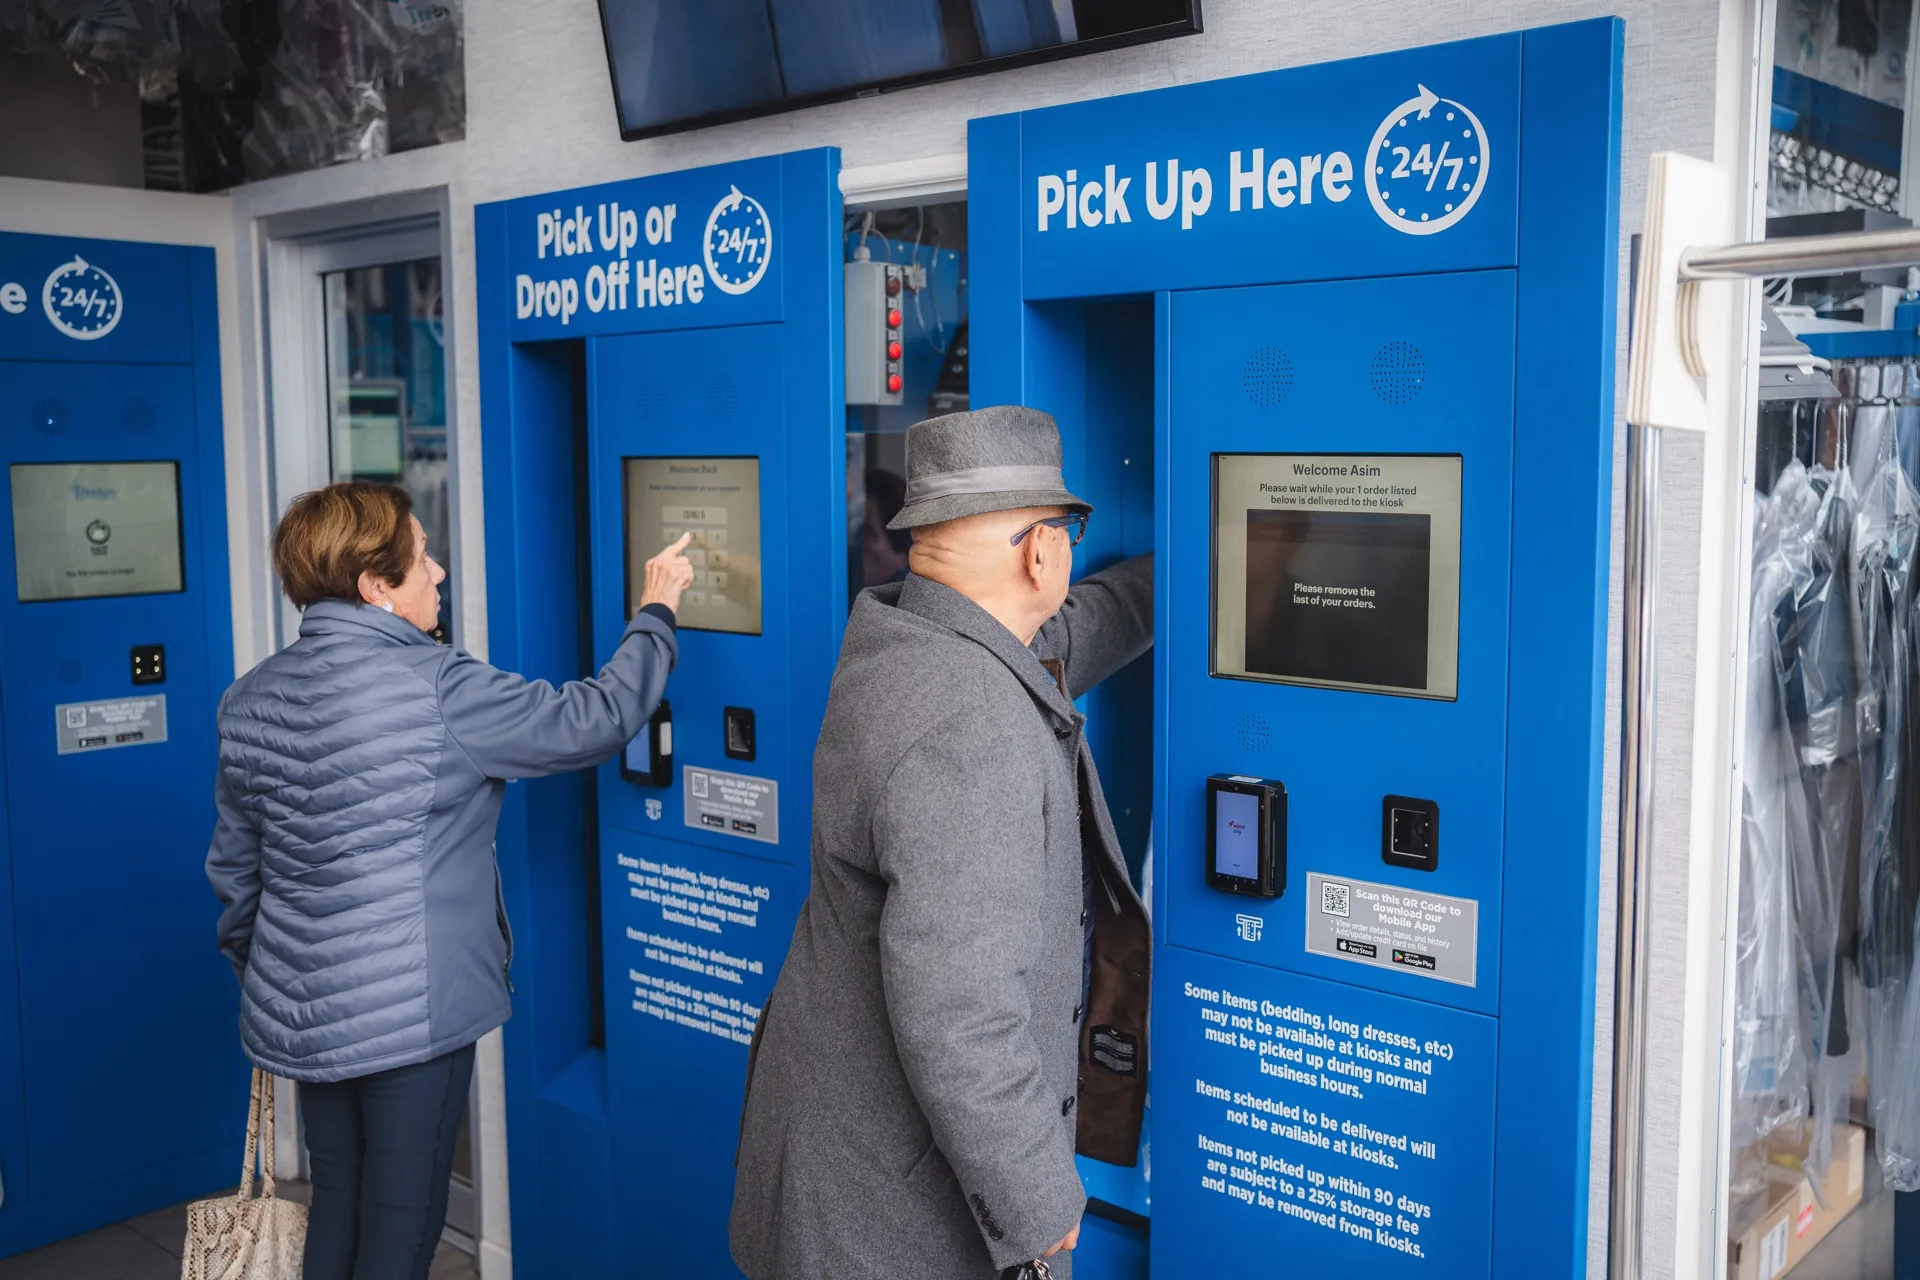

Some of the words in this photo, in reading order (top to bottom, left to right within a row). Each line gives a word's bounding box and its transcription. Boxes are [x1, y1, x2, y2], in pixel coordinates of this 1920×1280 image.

[1391, 141, 1463, 191] 24/7
[1038, 164, 1132, 231] Pick
[1146, 159, 1212, 229] Up
[1229, 148, 1353, 212] Here
[537, 206, 593, 259] Pick
[599, 202, 638, 258] Up
[645, 203, 676, 245] or
[718, 227, 757, 263] 24/7
[60, 287, 107, 318] 24/7
[516, 274, 579, 325] Drop
[585, 260, 629, 313] Off
[636, 258, 704, 308] Here
[1260, 483, 1287, 492] Please
[1289, 484, 1308, 493] wait
[1310, 485, 1333, 494] while
[1335, 487, 1354, 495] your
[1358, 486, 1361, 494] 1
[1364, 486, 1388, 494] order
[1391, 486, 1417, 495] listed
[1293, 464, 1347, 476] Welcome
[1351, 465, 1380, 476] Asim
[1271, 495, 1296, 504] below
[1298, 496, 1305, 504] is
[1308, 496, 1349, 505] delivered
[1363, 498, 1377, 506] the
[1380, 498, 1403, 507] kiosk
[1293, 594, 1309, 604] last
[1311, 596, 1320, 605] of
[1322, 598, 1341, 607] your
[1343, 598, 1375, 608] orders.
[1295, 583, 1322, 593] Please
[1325, 587, 1358, 595] remove
[1360, 587, 1375, 596] the
[1356, 890, 1379, 901] Scan
[1382, 893, 1400, 905] this
[1403, 897, 1417, 908] QR
[1421, 900, 1447, 913] Code
[1450, 906, 1461, 916] to
[1373, 903, 1423, 920] download
[1425, 912, 1442, 923] our
[1336, 919, 1350, 928] View
[1352, 922, 1368, 932] order
[1370, 926, 1391, 937] details,
[1393, 930, 1413, 940] status,
[1414, 934, 1426, 942] and
[1428, 936, 1449, 948] history
[1378, 914, 1412, 928] Mobile
[1414, 921, 1436, 933] App
[1360, 948, 1374, 956] Store
[1404, 957, 1422, 965] Google
[1423, 960, 1433, 968] Play
[1184, 982, 1219, 1003] Some
[1222, 990, 1257, 1012] items
[1261, 1000, 1325, 1031] (bedding,
[1329, 1015, 1358, 1038] long
[1363, 1024, 1420, 1053] dresses,
[1425, 1040, 1453, 1060] etc)
[1202, 1008, 1228, 1026] may
[1232, 1014, 1252, 1031] not
[1256, 1018, 1272, 1036] be
[1276, 1026, 1334, 1050] available
[1339, 1042, 1352, 1055] at
[1356, 1042, 1400, 1068] kiosks
[1404, 1056, 1431, 1075] and
[1205, 1028, 1236, 1046] must
[1240, 1034, 1256, 1050] be
[1259, 1041, 1302, 1063] picked
[1306, 1052, 1323, 1070] up
[1328, 1056, 1372, 1083] during
[1376, 1072, 1426, 1094] normal
[1260, 1058, 1317, 1086] business
[1320, 1076, 1363, 1099] hours.
[1196, 1079, 1230, 1101] Items
[1234, 1092, 1299, 1120] scheduled
[1303, 1108, 1317, 1124] to
[1321, 1112, 1338, 1131] be
[1342, 1120, 1406, 1150] delivered
[1411, 1140, 1436, 1159] will
[1227, 1108, 1248, 1126] not
[1252, 1113, 1268, 1131] be
[1271, 1120, 1330, 1150] available
[1333, 1138, 1347, 1154] at
[1351, 1139, 1398, 1169] kiosks.
[1198, 1134, 1232, 1157] Items
[1236, 1146, 1257, 1164] not
[1260, 1153, 1303, 1180] picked
[1307, 1170, 1324, 1186] up
[1328, 1172, 1370, 1200] within
[1375, 1188, 1393, 1206] 90
[1397, 1194, 1430, 1218] days
[1207, 1158, 1227, 1174] are
[1230, 1164, 1276, 1190] subject
[1280, 1179, 1294, 1195] to
[1297, 1186, 1305, 1198] a
[1308, 1186, 1336, 1208] 25%
[1340, 1198, 1392, 1226] storage
[1396, 1214, 1419, 1235] fee
[1202, 1176, 1224, 1192] and
[1228, 1184, 1254, 1204] may
[1258, 1190, 1274, 1209] be
[1278, 1199, 1336, 1229] removed
[1339, 1217, 1372, 1241] from
[1376, 1226, 1424, 1258] kiosks.
